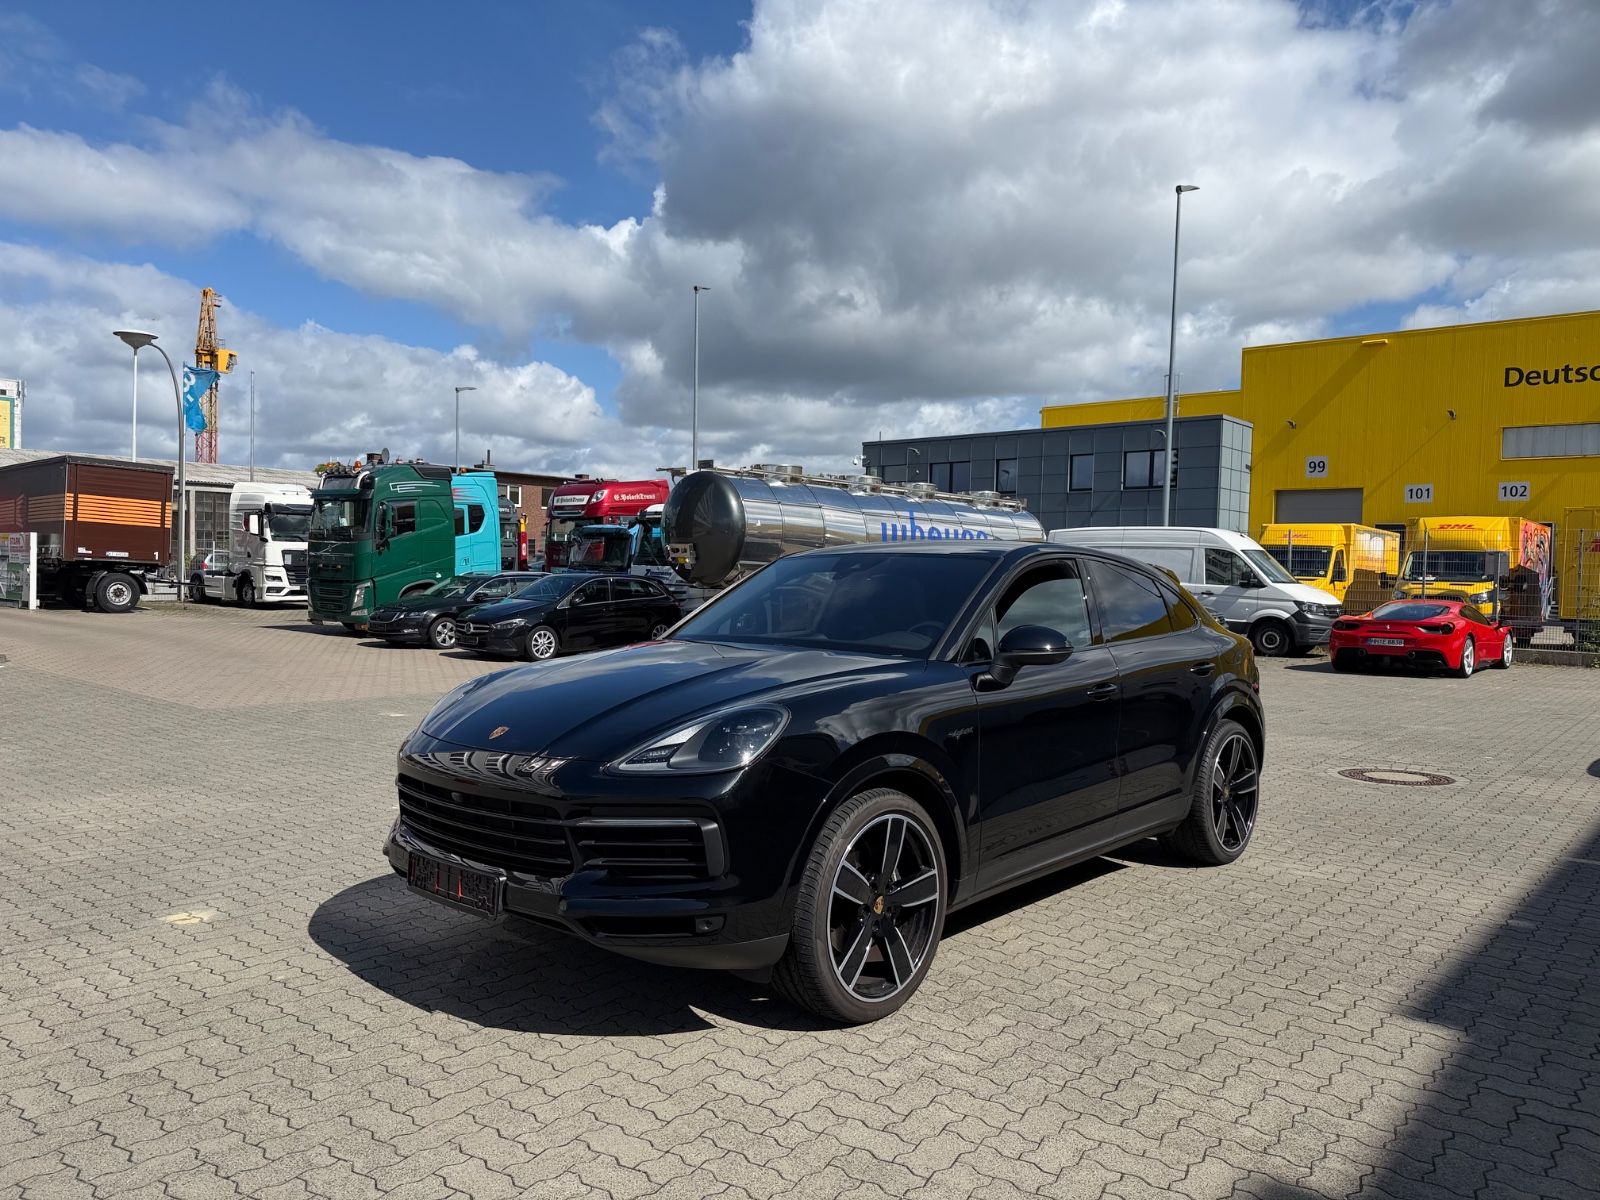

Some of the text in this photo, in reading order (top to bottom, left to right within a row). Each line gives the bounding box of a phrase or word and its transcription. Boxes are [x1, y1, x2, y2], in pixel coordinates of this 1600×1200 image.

[1308, 460, 1326, 473] 99
[1407, 487, 1431, 499] 101
[1501, 485, 1527, 498] 102
